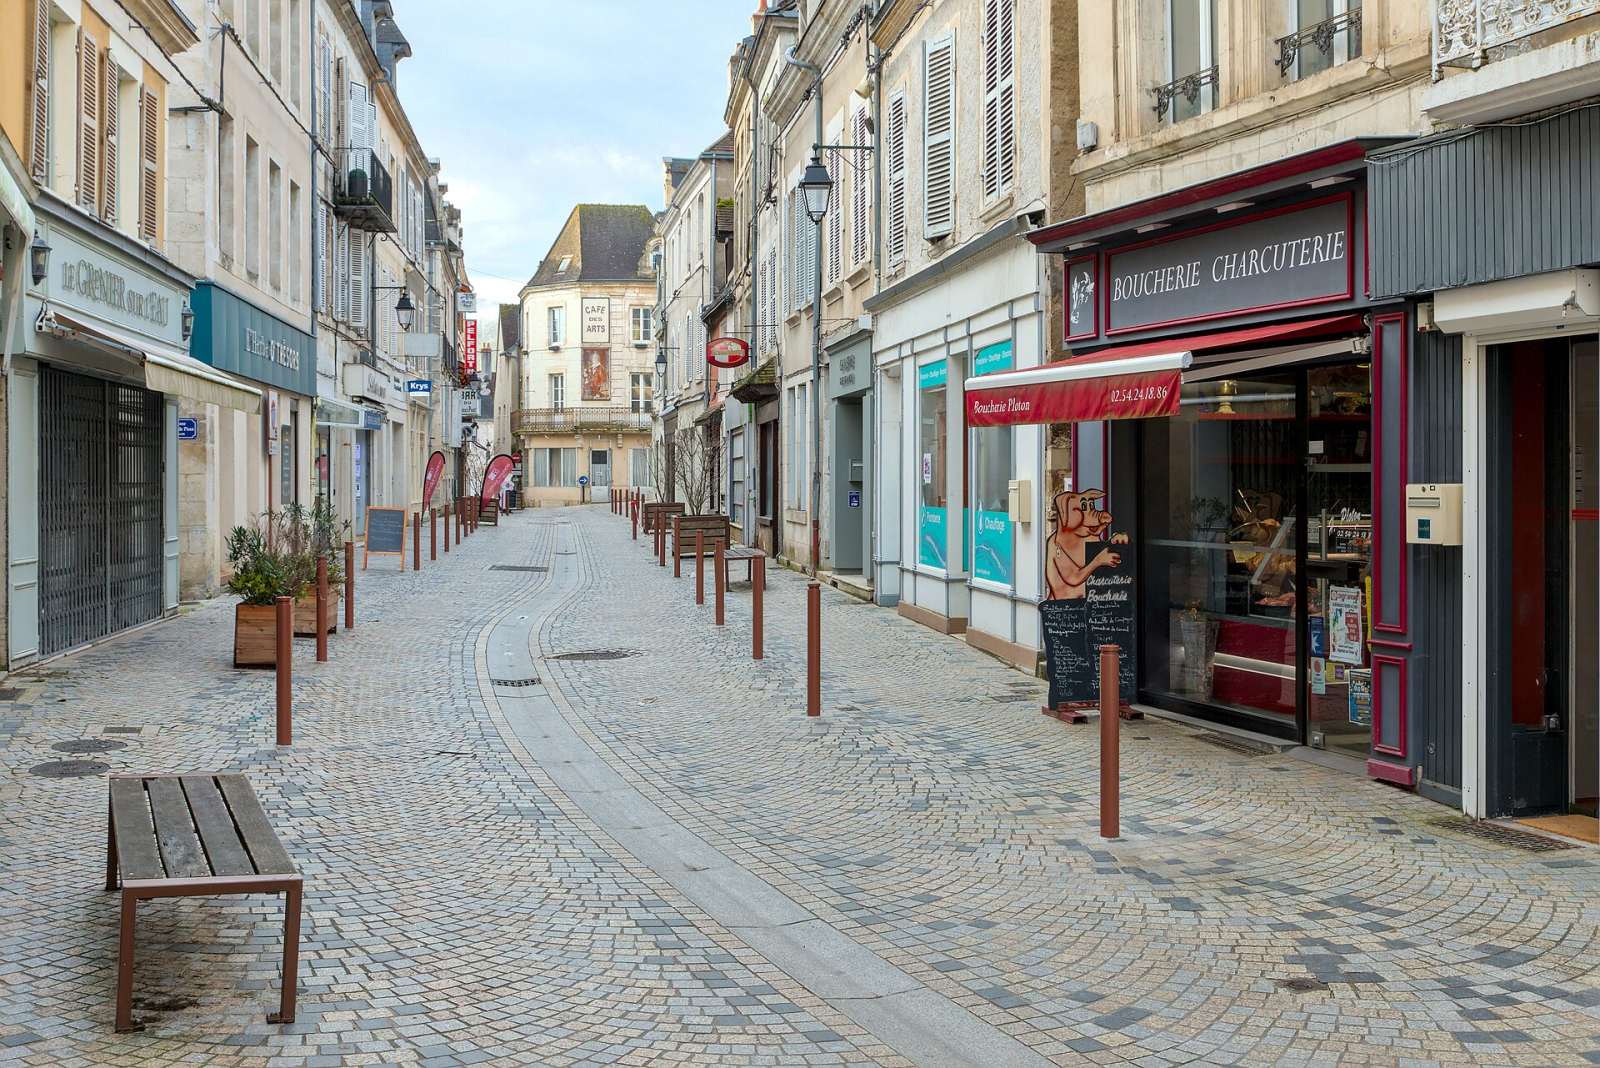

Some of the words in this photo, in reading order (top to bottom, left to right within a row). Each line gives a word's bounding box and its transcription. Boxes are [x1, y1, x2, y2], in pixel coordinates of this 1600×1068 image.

[1113, 261, 1201, 302] BOUCHERIE
[1212, 230, 1345, 282] CHARCUTERIE
[63, 261, 75, 290] LE
[587, 325, 606, 333] ARTS
[410, 382, 430, 391] Krys
[1110, 386, 1168, 403] 02.54.24.18.86
[974, 400, 1006, 414] Boucherie
